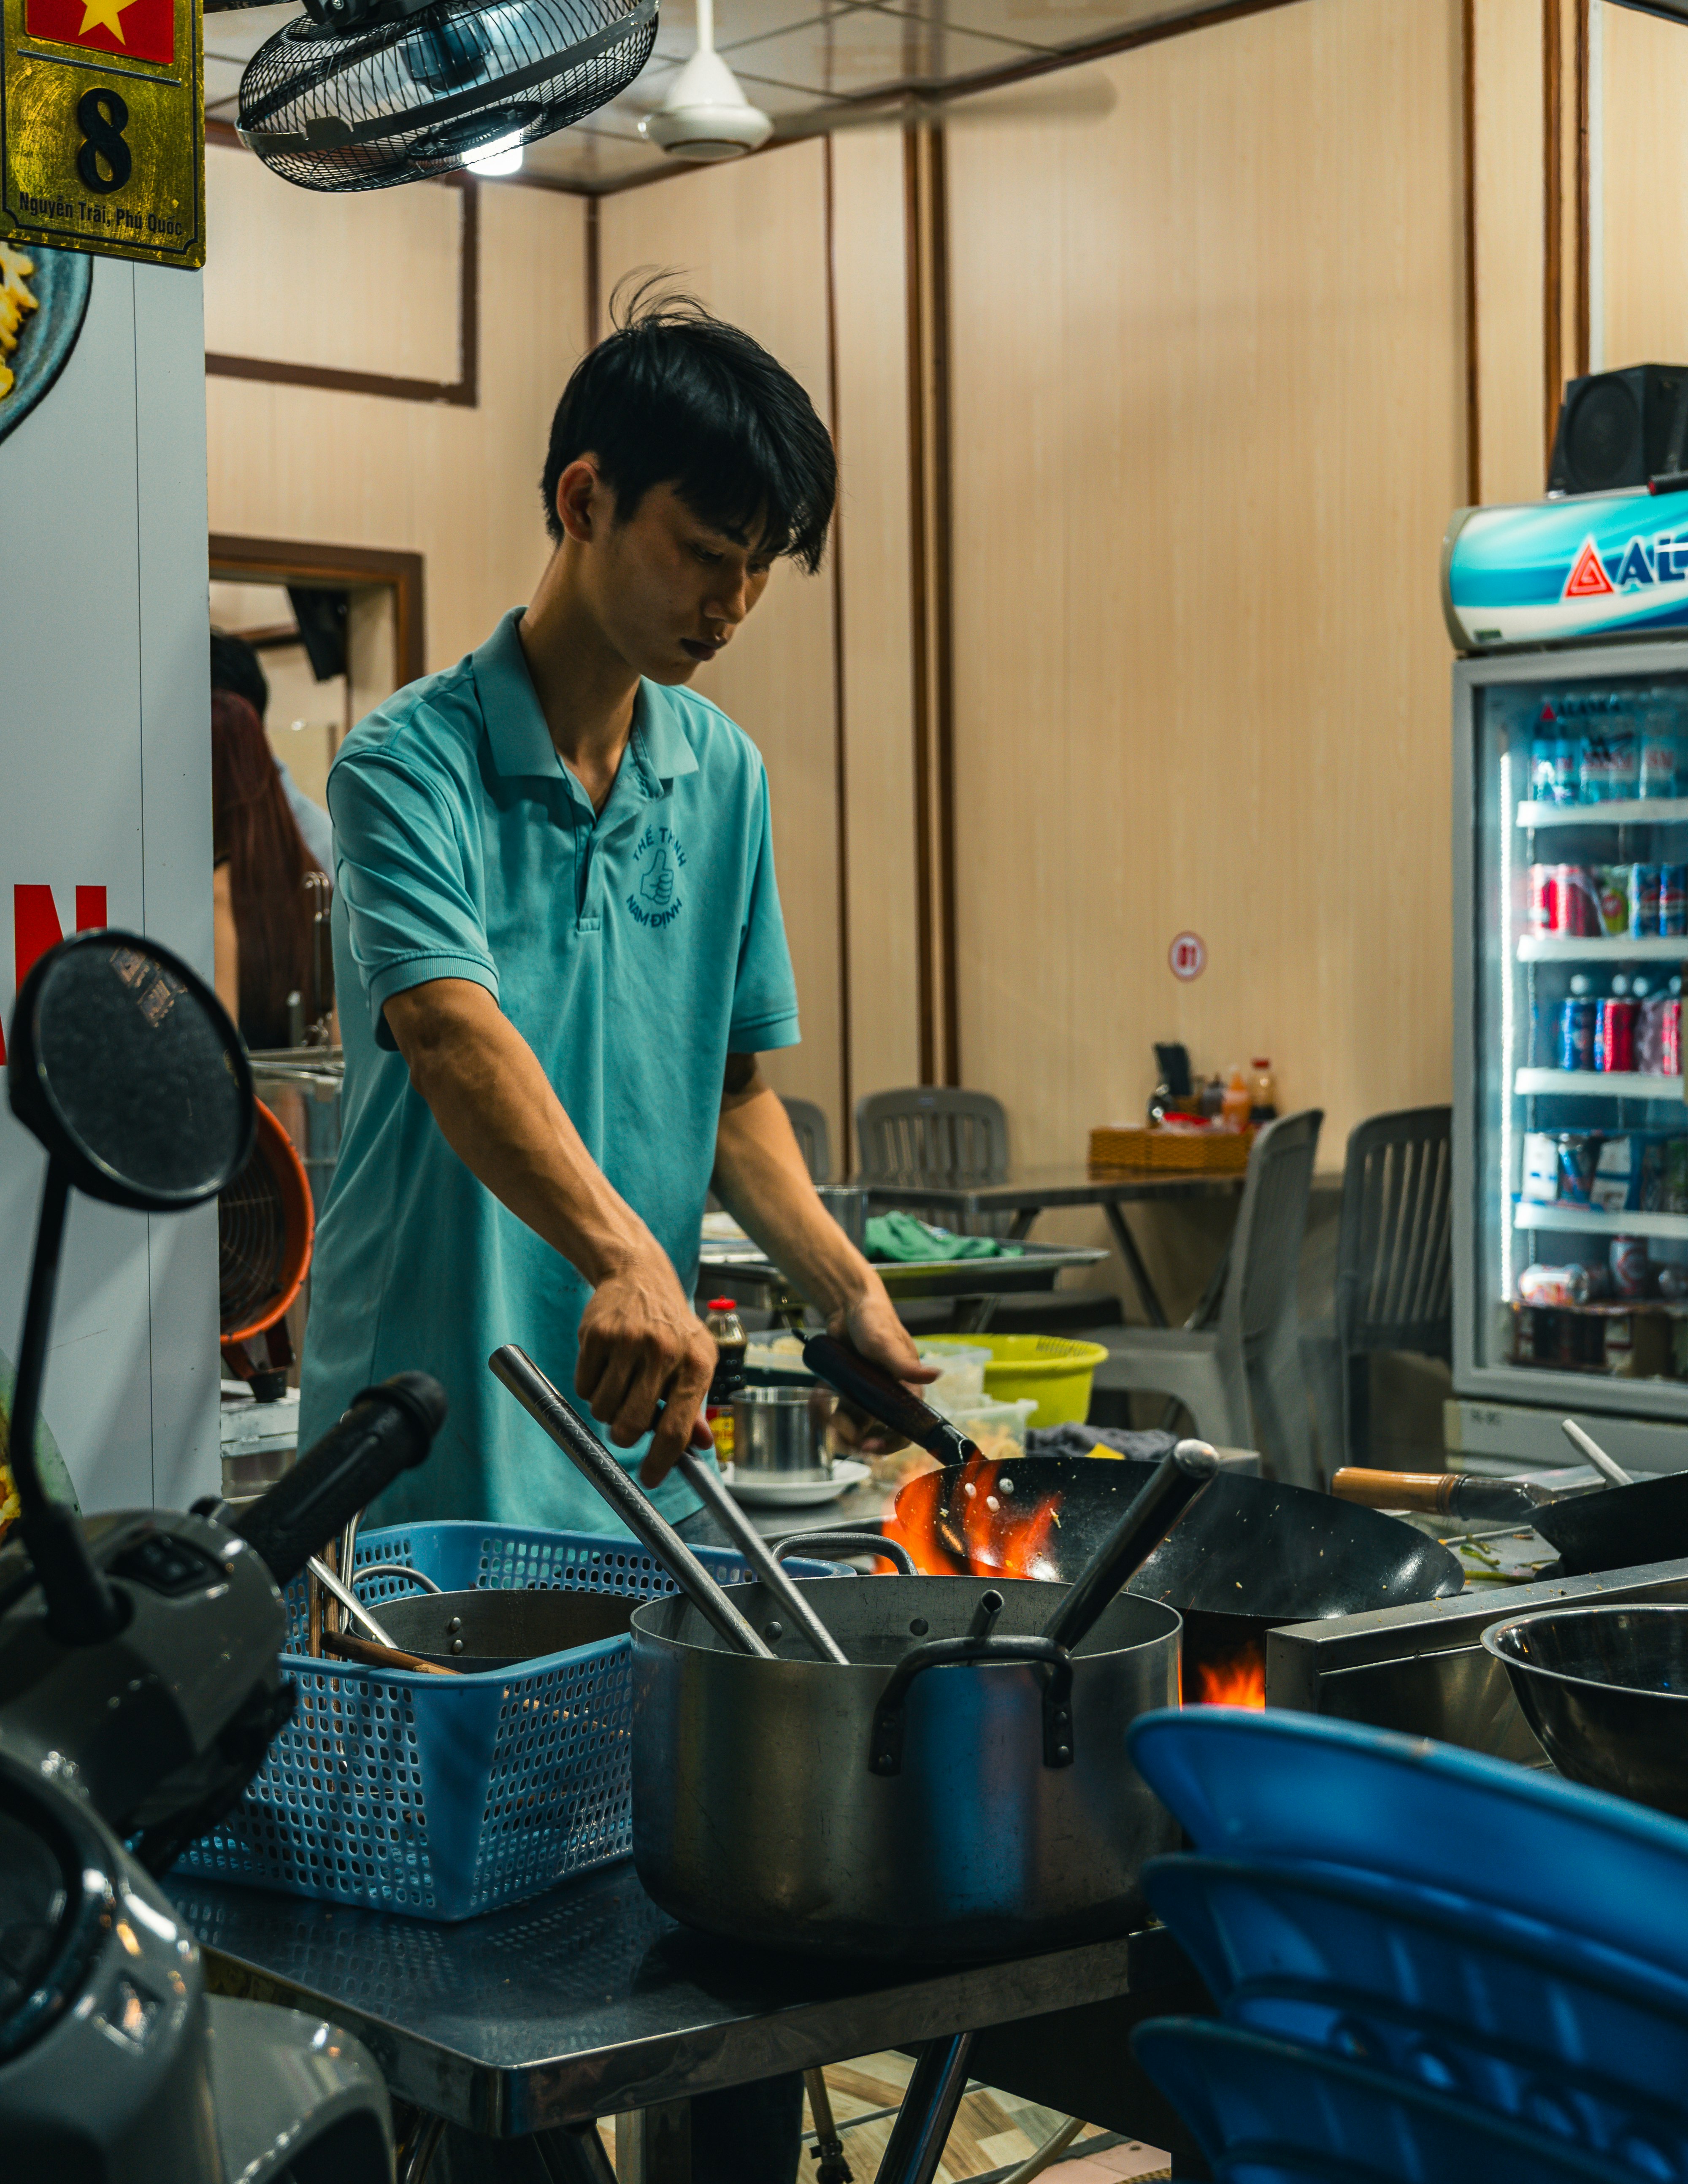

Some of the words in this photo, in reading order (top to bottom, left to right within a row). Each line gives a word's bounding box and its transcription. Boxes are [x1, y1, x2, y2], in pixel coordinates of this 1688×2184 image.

[78, 88, 132, 193] 8
[19, 191, 73, 219] Nguyễn
[78, 201, 111, 227] Trãi,
[116, 207, 143, 230] Phú
[148, 212, 183, 236] Quốc
[626, 894, 650, 926] NAM
